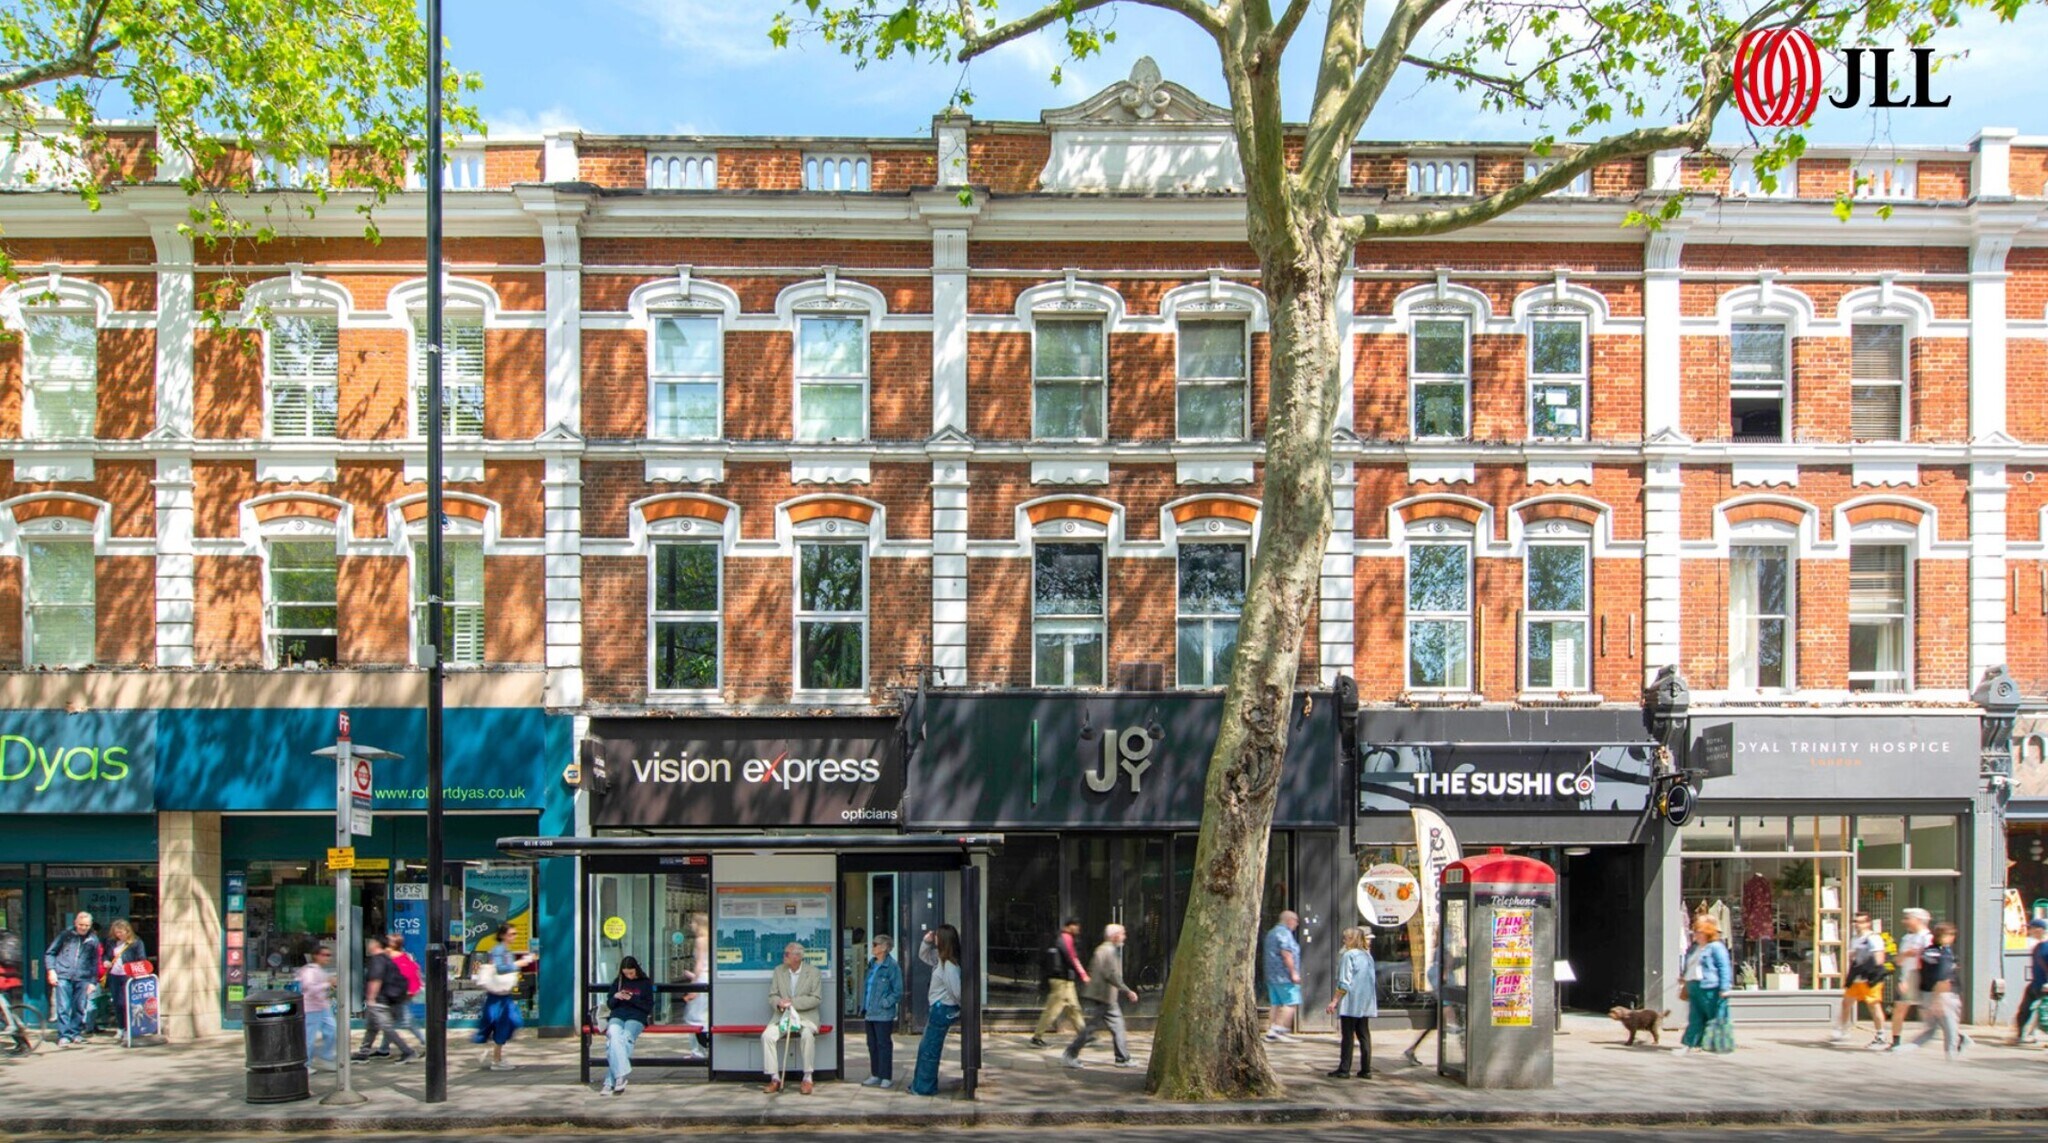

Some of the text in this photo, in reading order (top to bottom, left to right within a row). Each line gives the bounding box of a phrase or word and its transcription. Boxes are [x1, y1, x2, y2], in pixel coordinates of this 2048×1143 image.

[1737, 742, 1950, 753] OYAL TRINITY HOSPICE
[0, 734, 129, 791] Dyas
[1085, 726, 1153, 793] JOY
[631, 751, 881, 790] vision express
[1413, 772, 1467, 795] THE
[1471, 772, 1551, 795] SUSHI
[841, 808, 898, 821] opticians
[472, 898, 498, 914] Dyas
[1491, 895, 1537, 907] Telephone
[1497, 916, 1522, 926] FUN
[1496, 974, 1521, 985] FUN
[131, 980, 155, 993] KEYS
